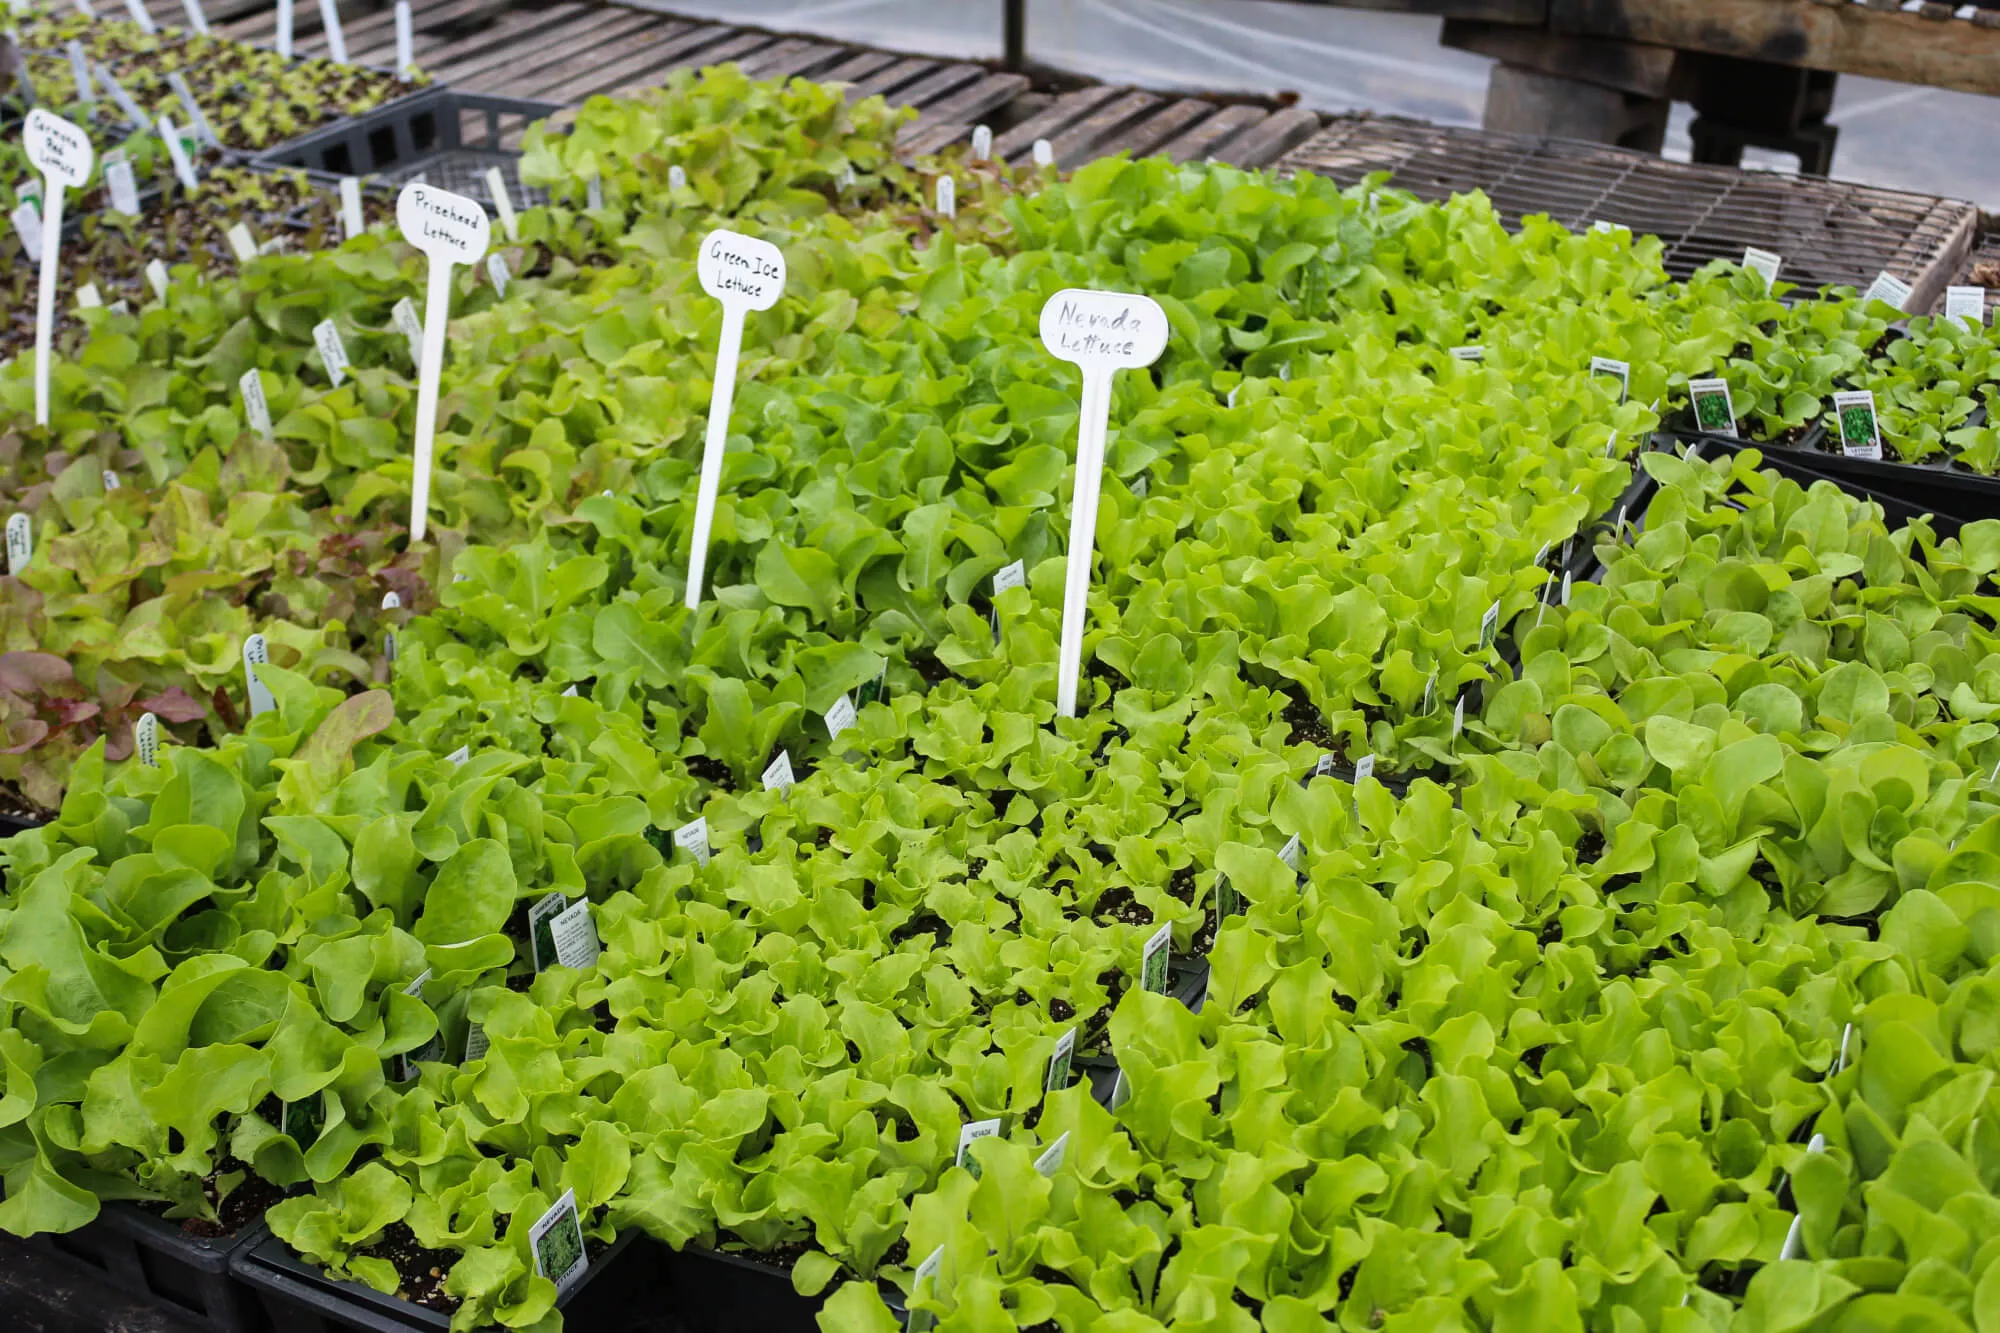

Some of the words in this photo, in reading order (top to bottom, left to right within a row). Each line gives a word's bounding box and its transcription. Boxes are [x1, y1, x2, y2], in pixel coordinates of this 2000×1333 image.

[413, 191, 479, 229] Prizehead
[423, 221, 466, 250] Lettuce
[711, 240, 750, 269] Green
[752, 257, 779, 280] Ice
[717, 269, 762, 297] Lettuce
[1059, 301, 1141, 332] Nevada
[1061, 333, 1135, 356] Lettuce
[560, 909, 582, 925] NEVADA
[542, 1204, 566, 1229] NEVADA
[556, 1262, 578, 1287] ETTUCE
